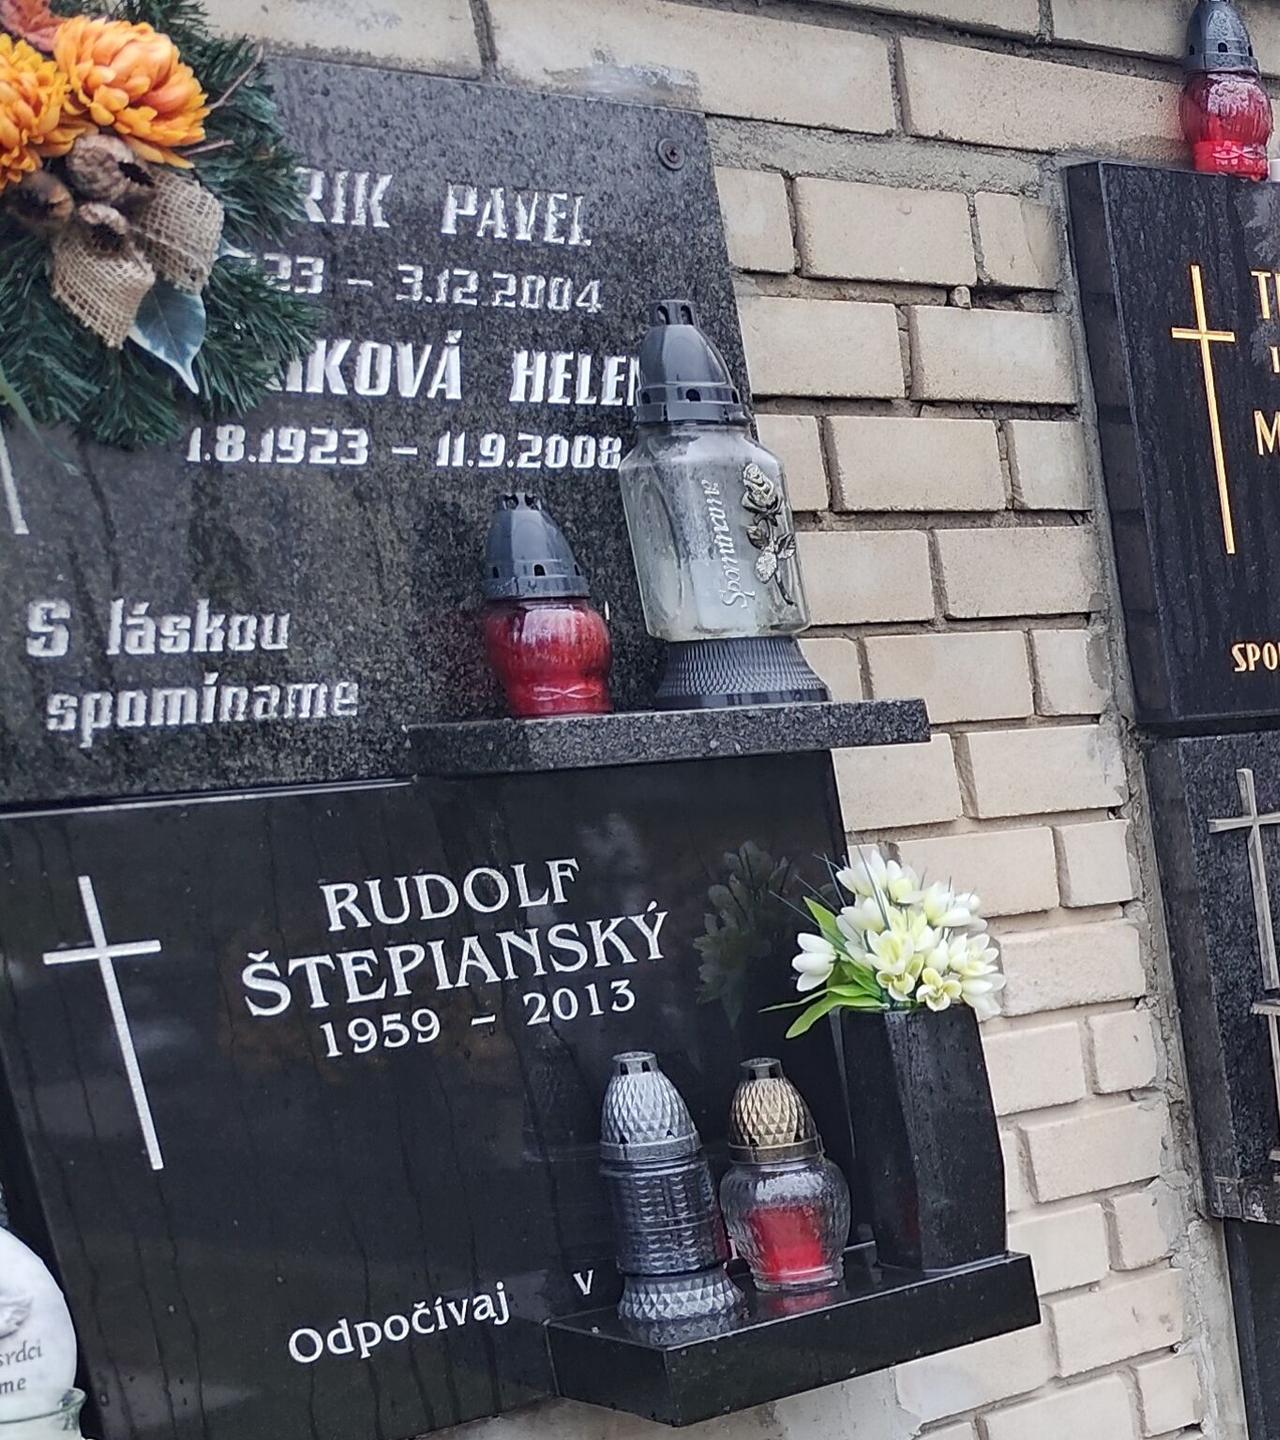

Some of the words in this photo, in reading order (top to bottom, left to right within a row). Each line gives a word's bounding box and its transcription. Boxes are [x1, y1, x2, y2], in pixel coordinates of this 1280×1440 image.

[441, 180, 592, 247] PAVEL
[396, 264, 602, 314] 3.12.2004
[435, 430, 623, 470] 11.9.2008
[26, 598, 71, 657] S
[106, 597, 292, 656] láskou
[46, 672, 359, 749] spomíname
[319, 857, 580, 932] RUDOLF
[241, 900, 670, 1017] ŠTEPIANSKÝ
[319, 1007, 442, 1058] 1959
[522, 978, 637, 1027] 2013
[287, 1281, 511, 1364] Odpočívaj
[573, 1269, 595, 1296] v
